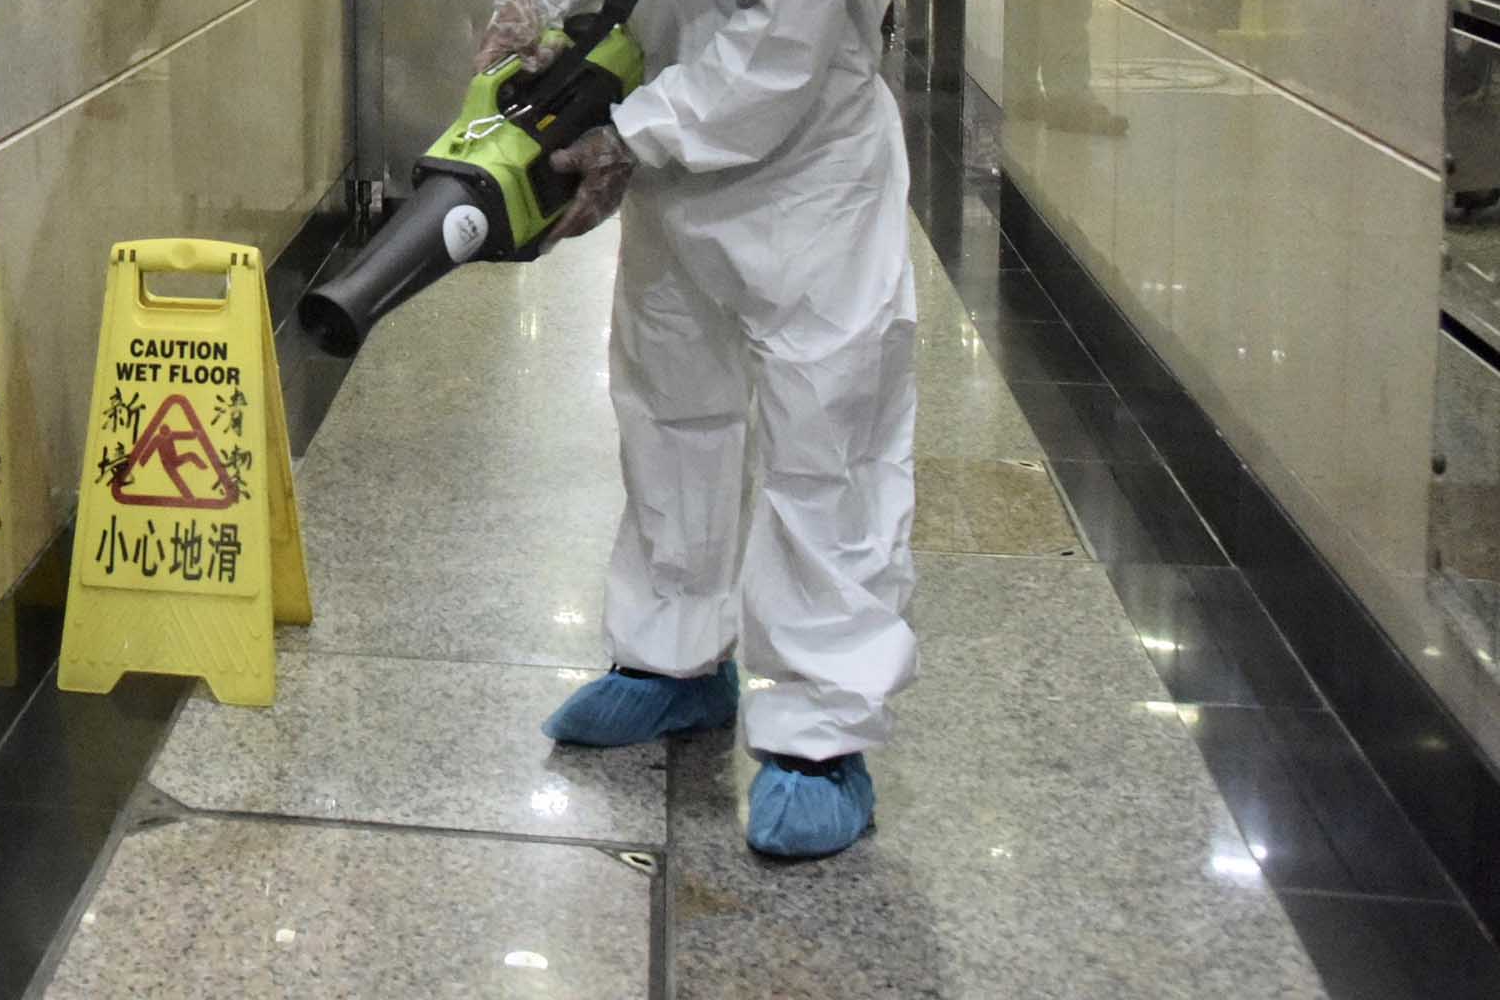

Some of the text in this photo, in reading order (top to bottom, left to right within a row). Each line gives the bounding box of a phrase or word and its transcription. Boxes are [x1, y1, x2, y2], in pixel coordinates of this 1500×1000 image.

[130, 338, 228, 361] CAUTION
[116, 362, 241, 385] WET FLOOR
[95, 515, 242, 583] 小心地滑
